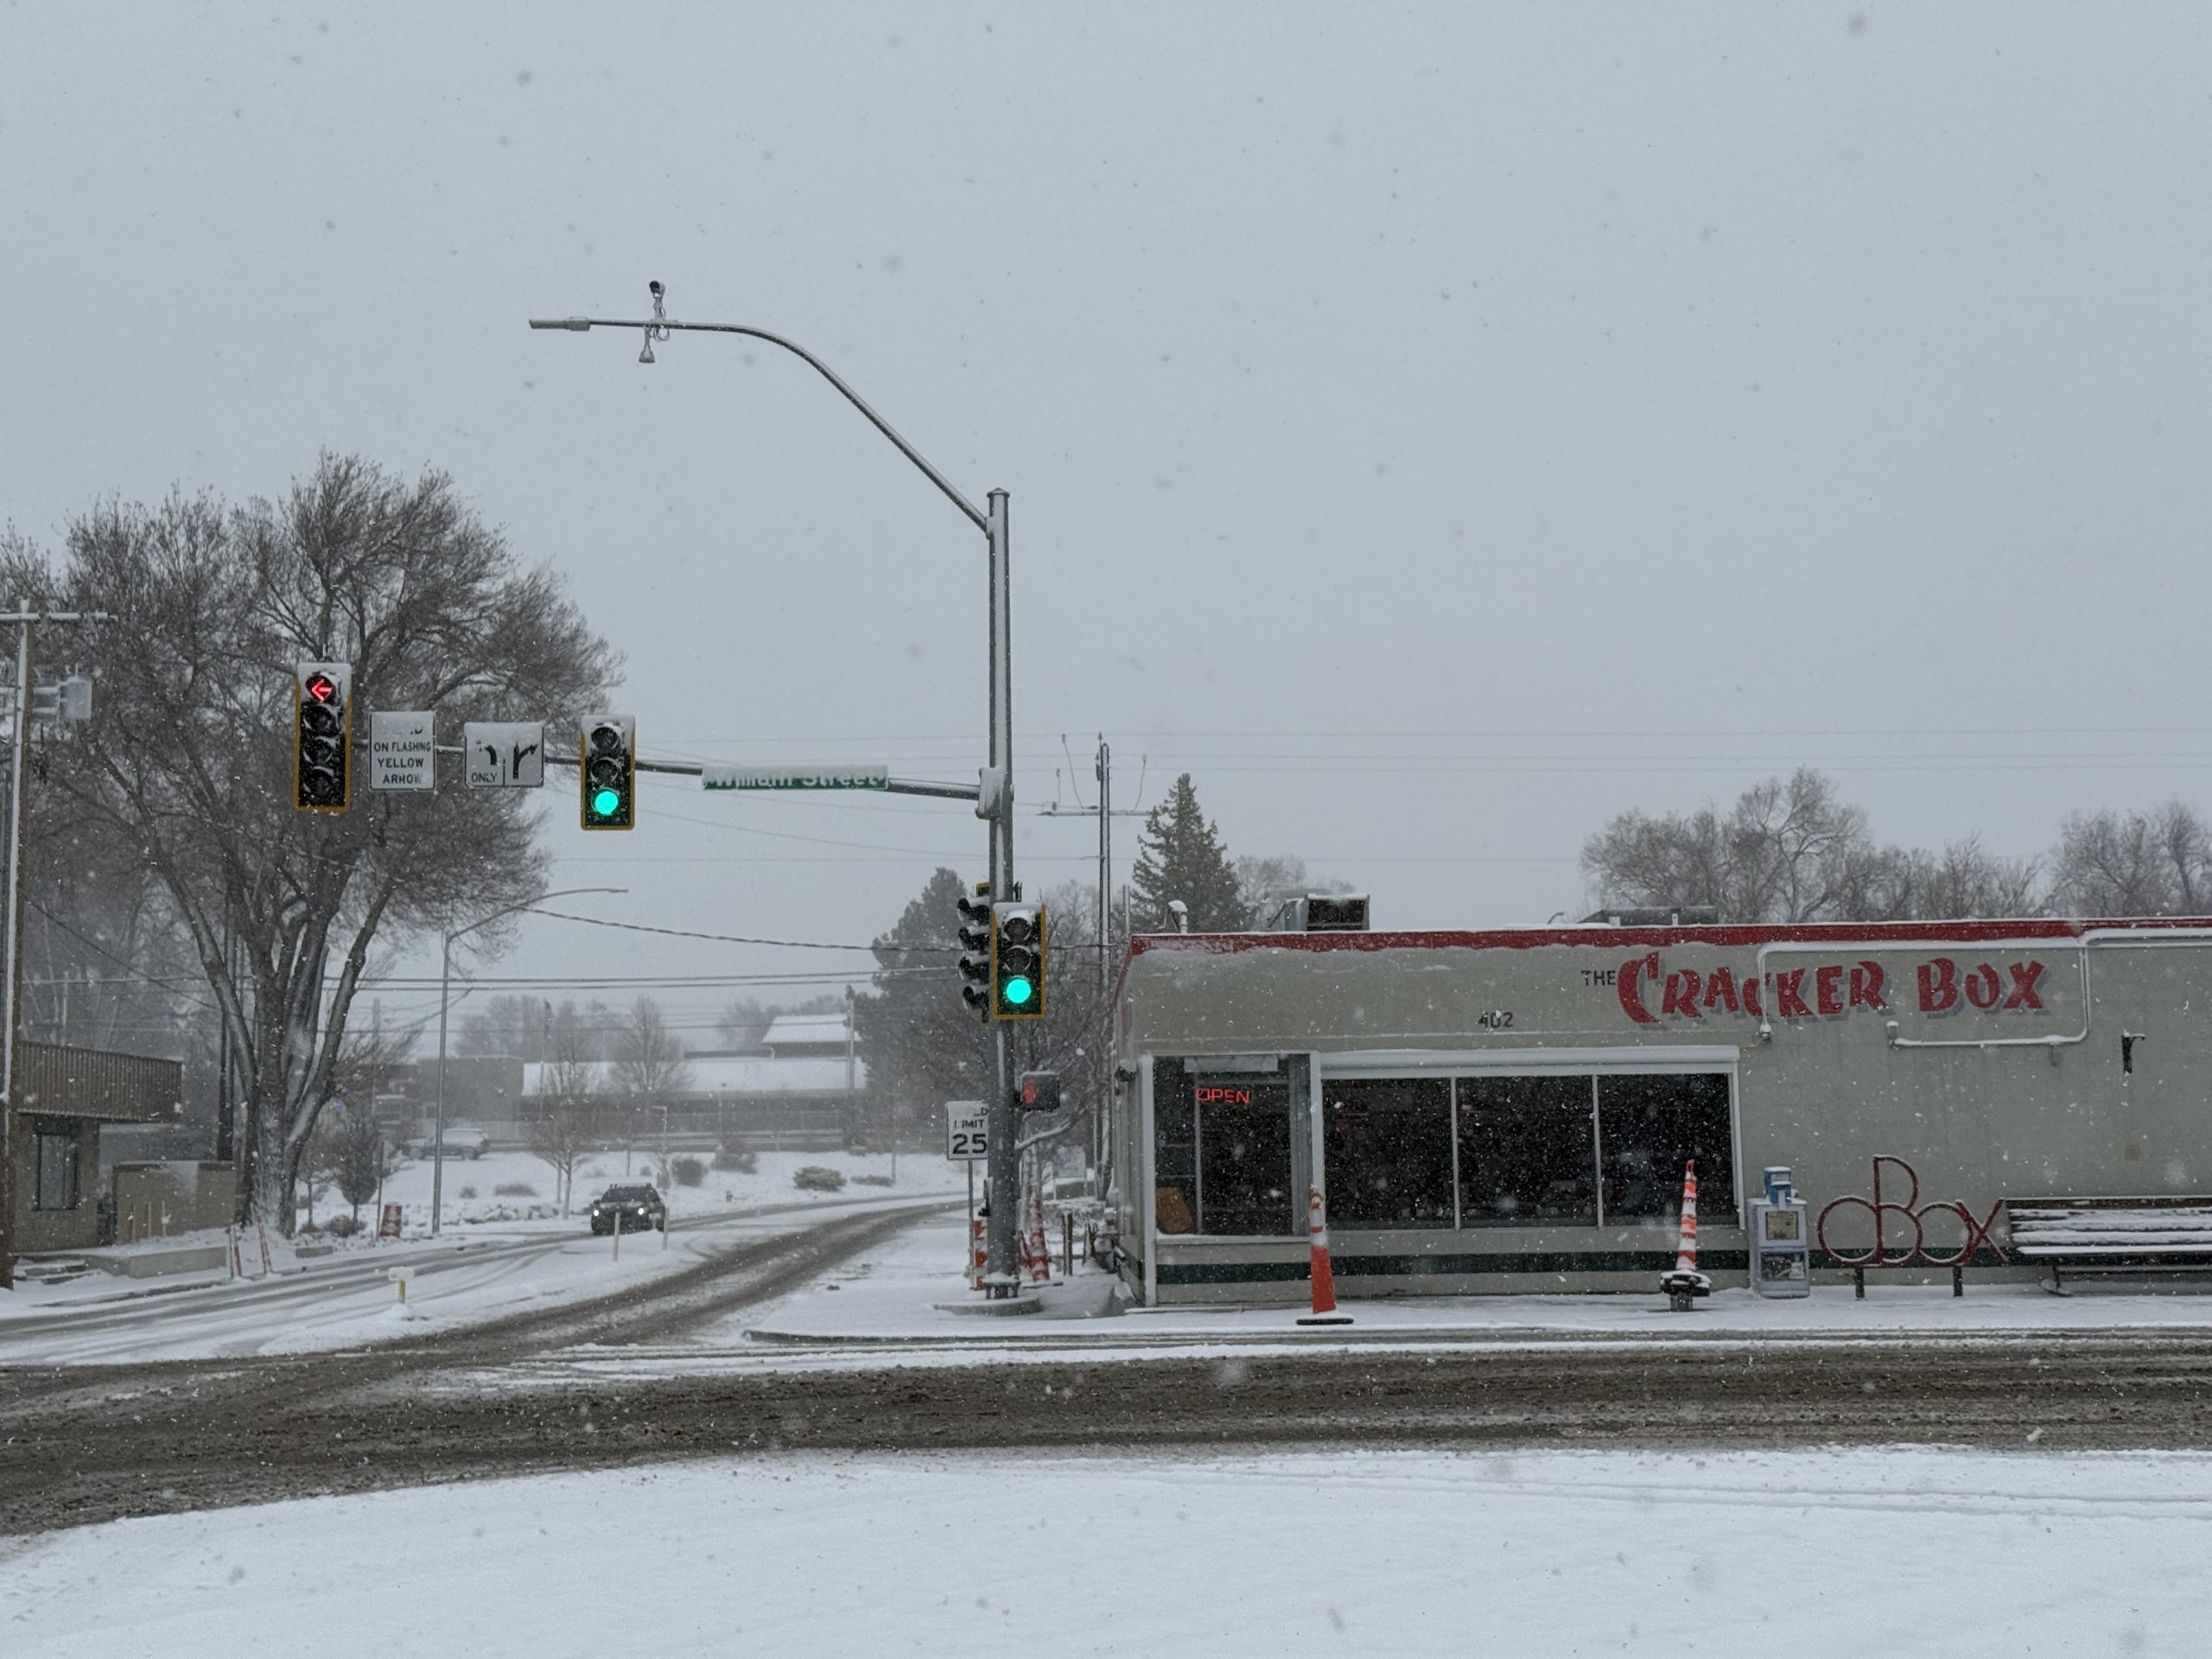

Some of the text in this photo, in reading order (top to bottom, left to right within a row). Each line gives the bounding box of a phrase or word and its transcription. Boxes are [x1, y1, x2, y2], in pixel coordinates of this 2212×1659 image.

[373, 741, 431, 753] ON FLASHING
[377, 757, 424, 768] YELLOW
[382, 773, 423, 785] ARROW
[471, 772, 498, 783] ONLY
[1580, 950, 2047, 1024] THE CRACKER BOX
[1478, 1011, 1514, 1029] 402
[1195, 1087, 1251, 1104] OPEN
[952, 1133, 988, 1154] 25
